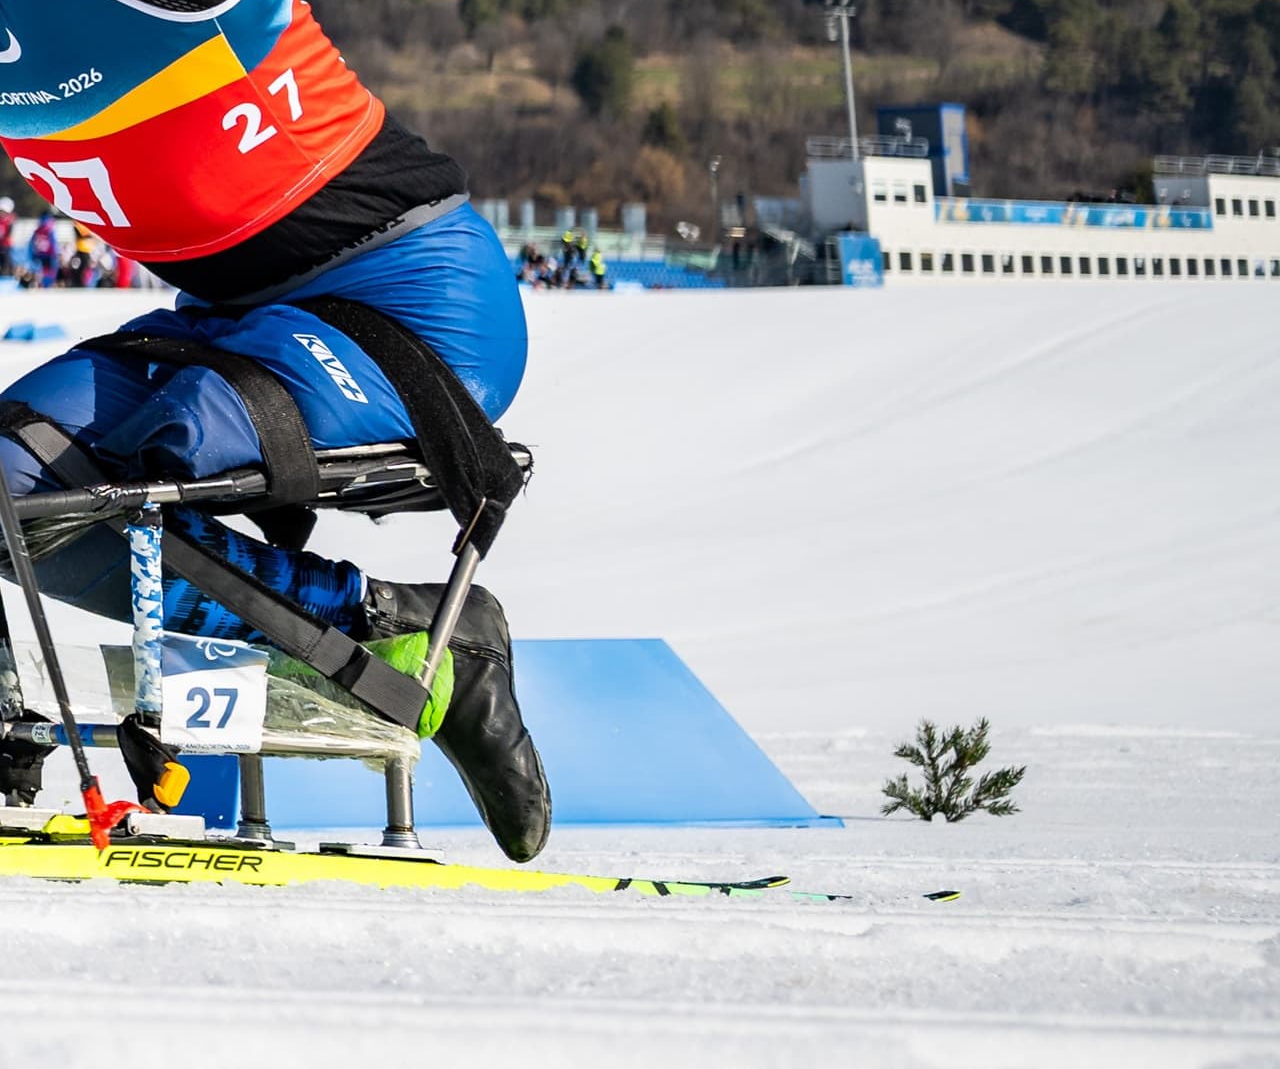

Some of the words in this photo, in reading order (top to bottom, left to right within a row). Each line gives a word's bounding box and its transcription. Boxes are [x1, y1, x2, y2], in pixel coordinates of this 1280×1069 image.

[58, 67, 103, 98] 2026
[222, 68, 303, 154] 27
[13, 156, 132, 228] 27
[186, 686, 238, 729] 27
[105, 850, 263, 873] FISCHER
